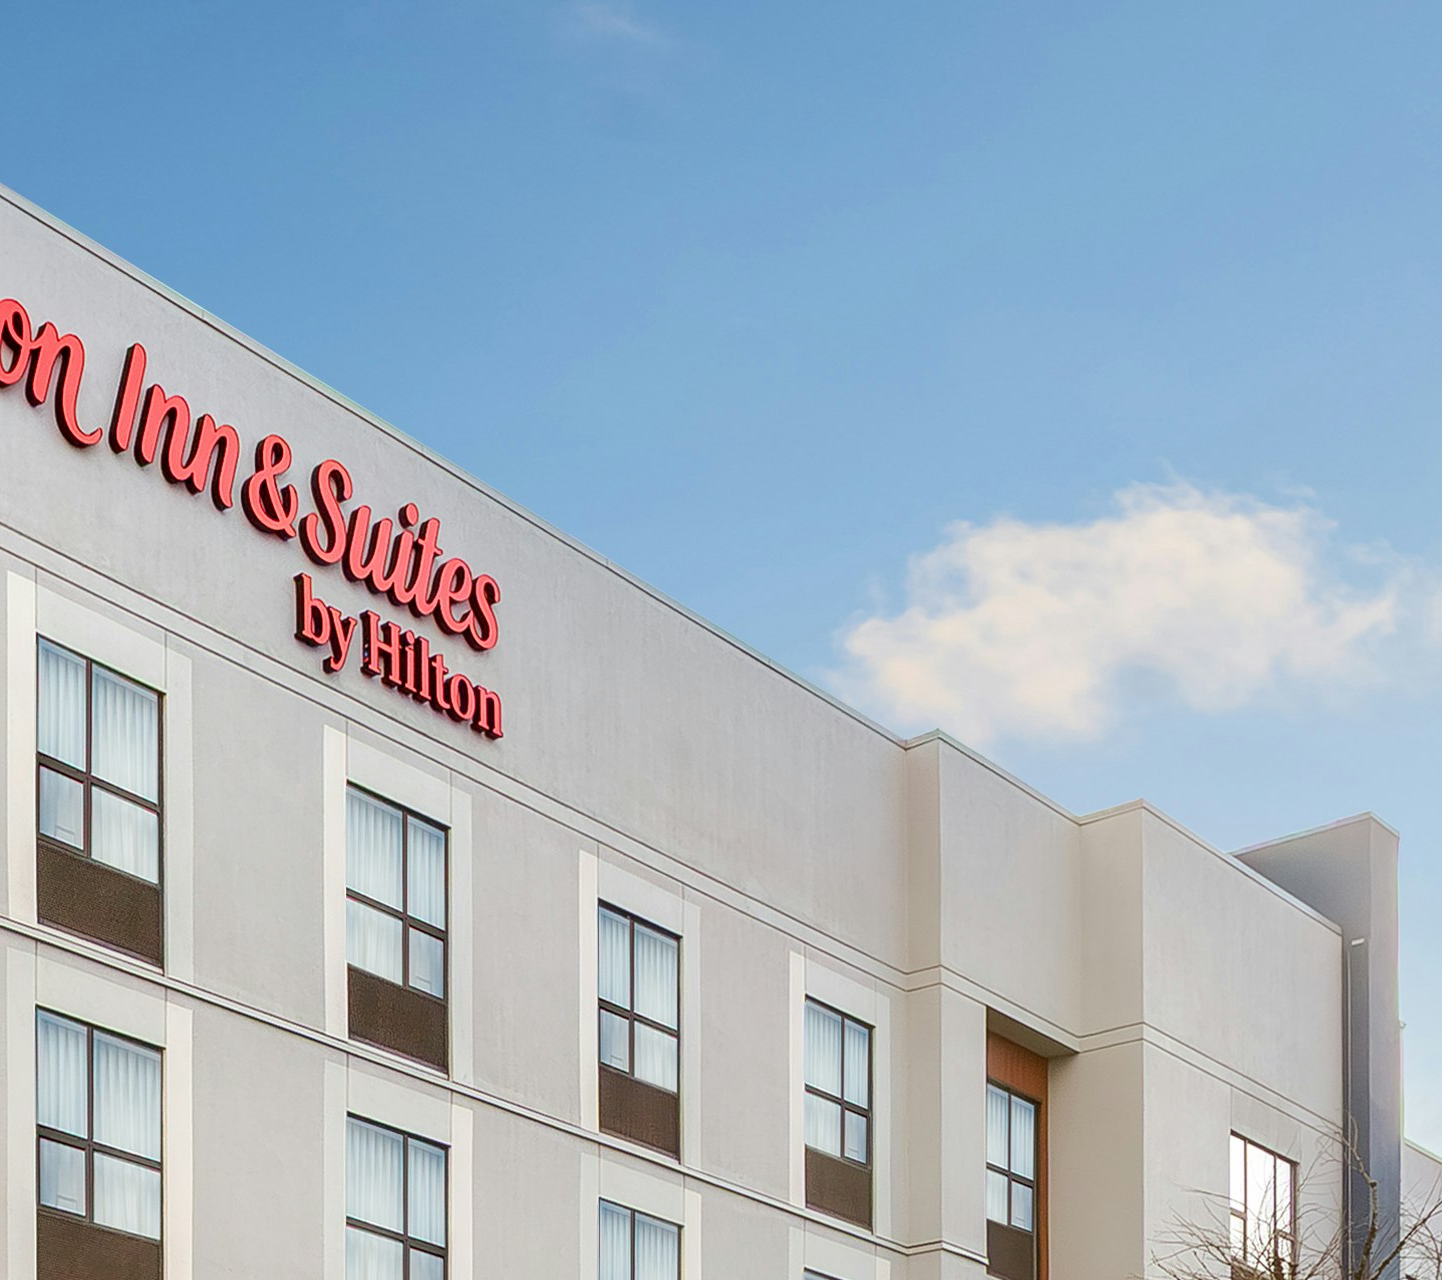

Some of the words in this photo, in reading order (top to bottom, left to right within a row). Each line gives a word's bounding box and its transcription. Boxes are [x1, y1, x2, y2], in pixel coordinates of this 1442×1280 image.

[108, 343, 240, 511] Inn
[241, 434, 299, 540] &
[298, 459, 501, 650] Suites
[293, 572, 357, 674] by
[359, 609, 504, 740] Hilton
